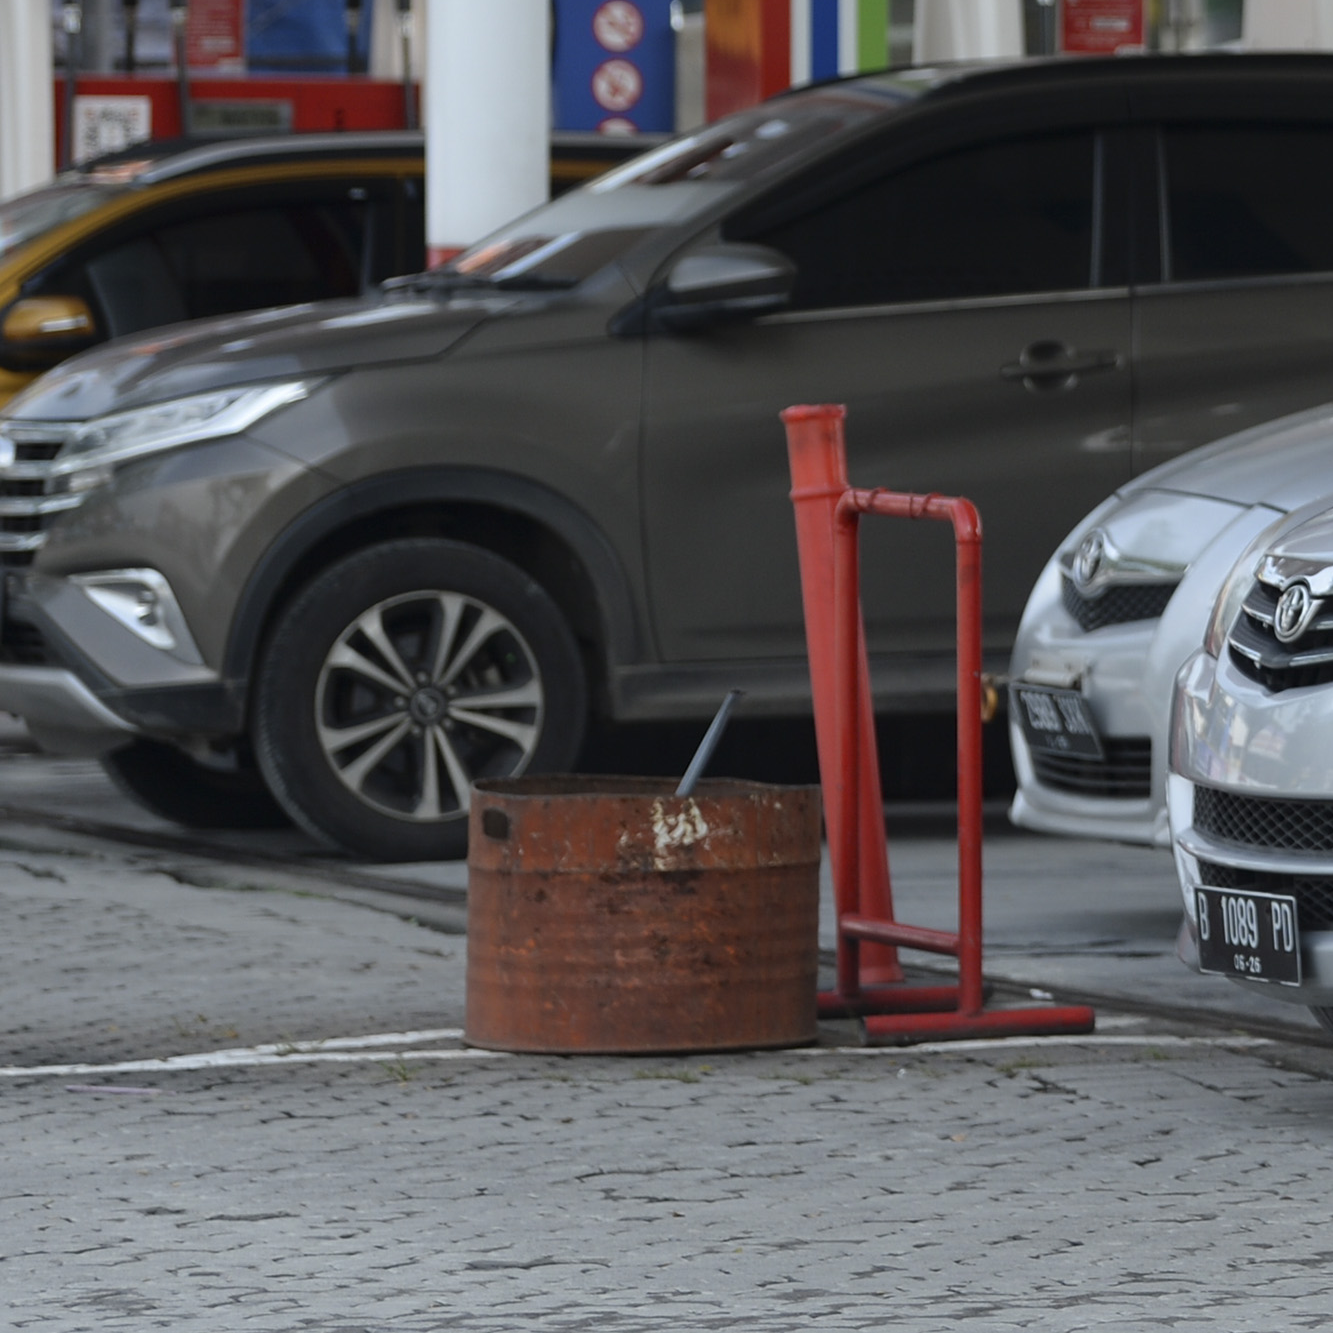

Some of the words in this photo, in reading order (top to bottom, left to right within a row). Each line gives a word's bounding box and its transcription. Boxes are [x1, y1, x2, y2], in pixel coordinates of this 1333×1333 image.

[1197, 891, 1210, 941] B
[1221, 895, 1259, 949] 1089
[1271, 901, 1294, 953] PD
